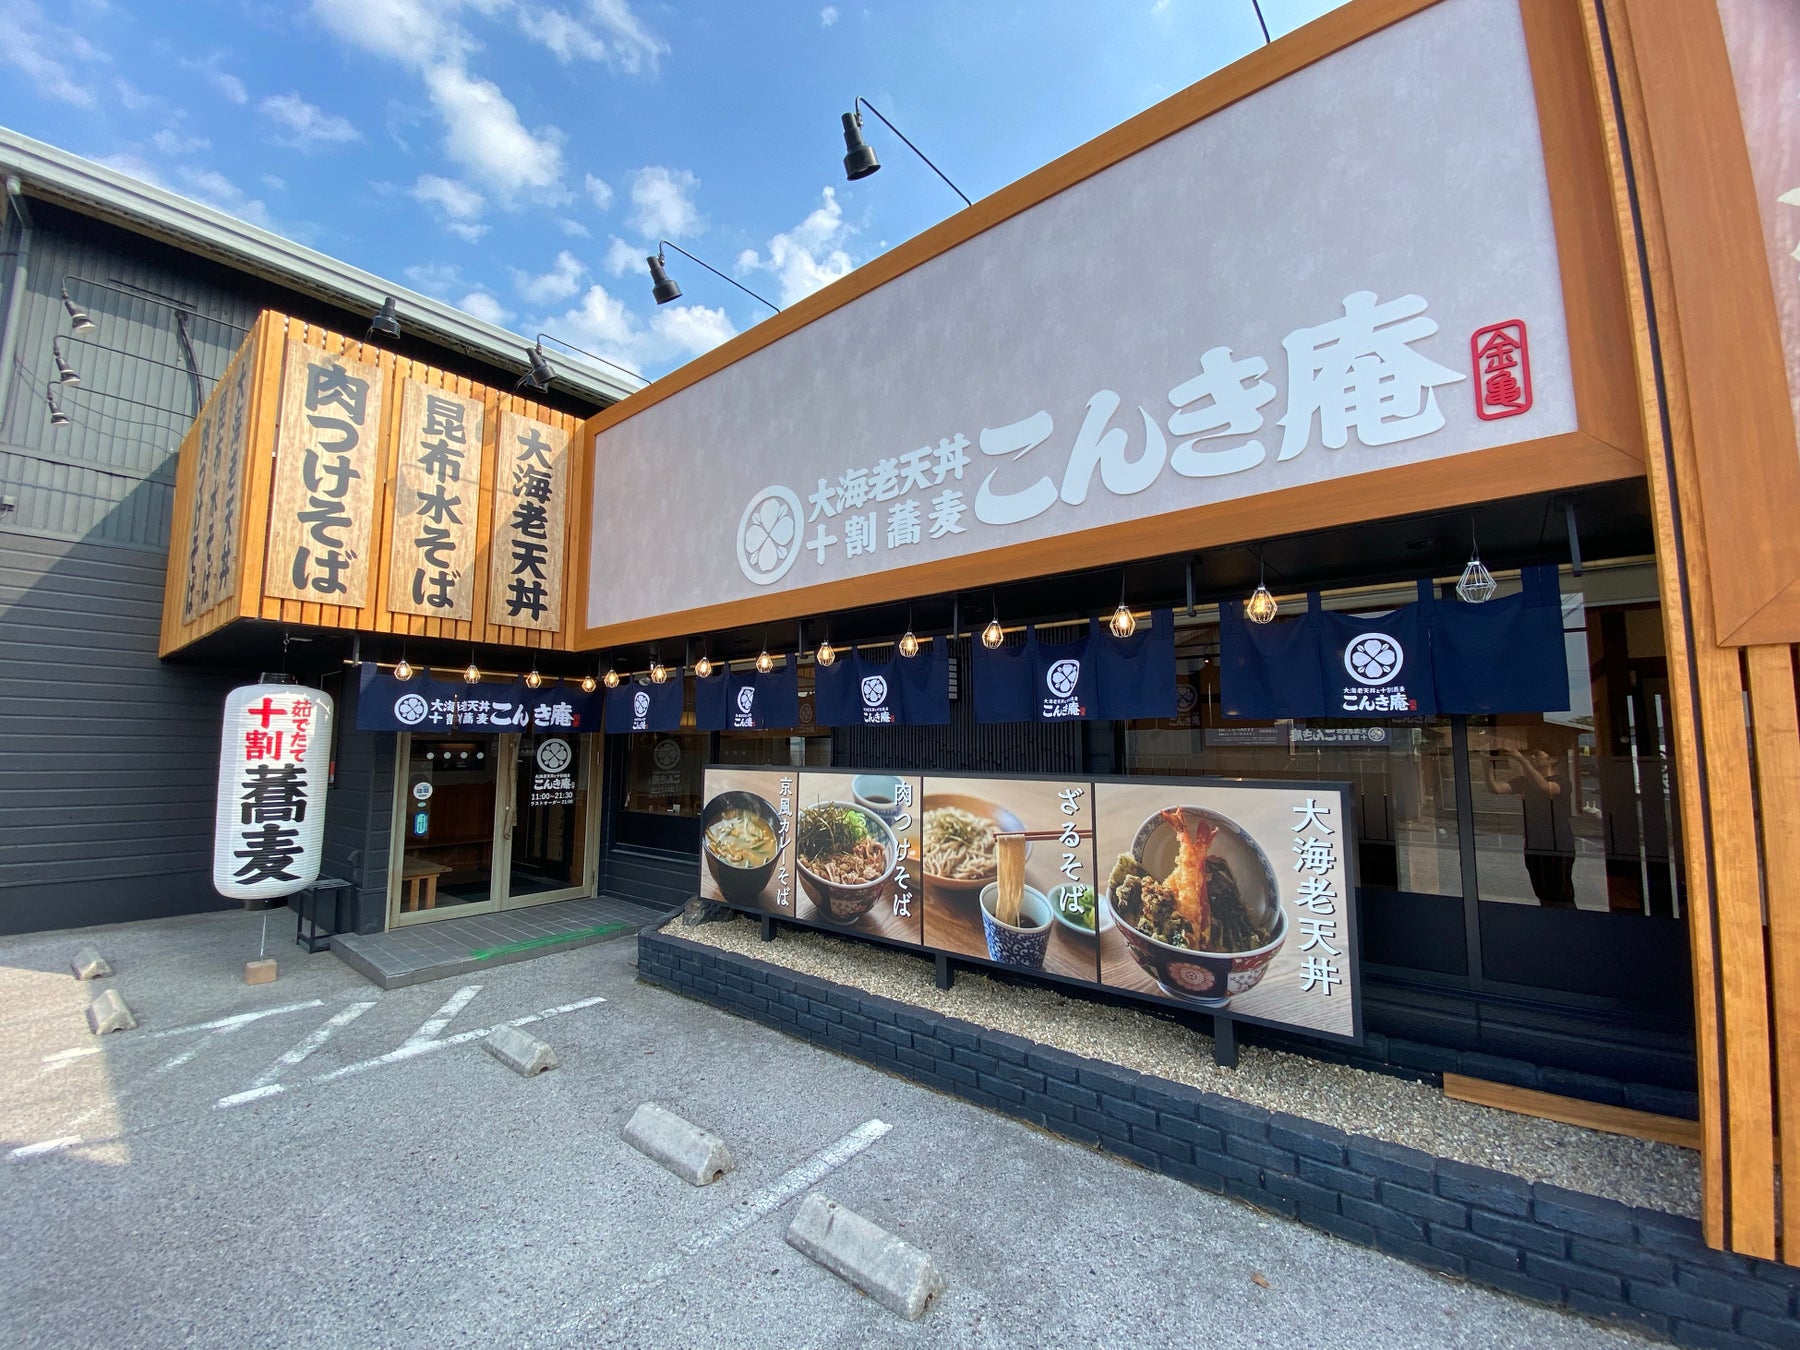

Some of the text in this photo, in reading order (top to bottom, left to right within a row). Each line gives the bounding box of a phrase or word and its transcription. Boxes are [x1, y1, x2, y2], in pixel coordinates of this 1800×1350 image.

[974, 290, 1468, 525] こんき庵
[292, 362, 370, 595] 肉つけそば
[413, 394, 466, 609] 昆布水そば
[506, 428, 553, 622] 大海老天丼
[806, 489, 967, 565] 十割蕎麦
[808, 433, 971, 522] 大海老天丼
[289, 699, 312, 762] 茹でたて
[490, 702, 574, 727] こんき庵
[1043, 701, 1080, 717] こんき庵
[1343, 693, 1410, 711] こんき庵
[233, 697, 308, 885] 十割蕎麦
[534, 778, 571, 790] こんき庵
[777, 776, 793, 906] 京風カレーそば
[892, 782, 914, 918] 肉つけそば
[1057, 787, 1086, 915] ざるそば
[1290, 798, 1342, 996] 大海老天丼
